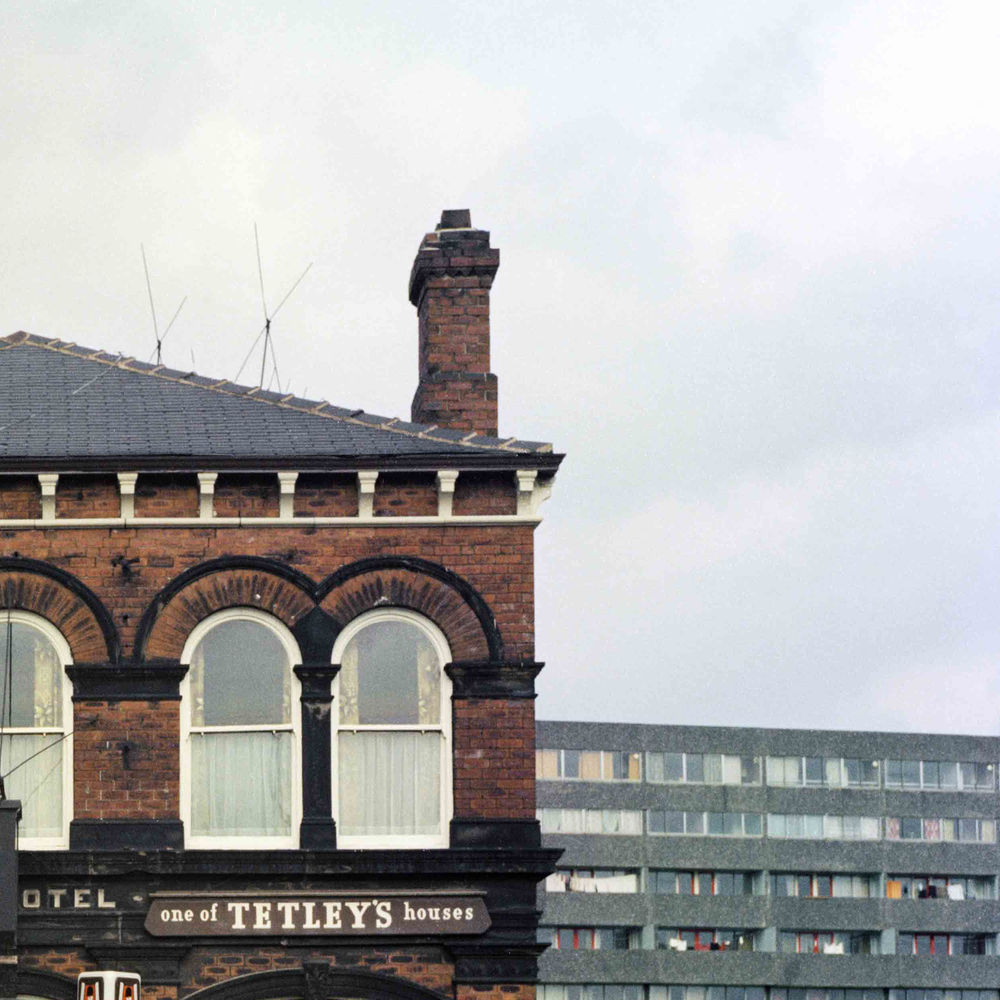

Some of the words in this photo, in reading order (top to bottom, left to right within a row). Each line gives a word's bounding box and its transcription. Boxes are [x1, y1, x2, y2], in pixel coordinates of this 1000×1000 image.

[22, 888, 116, 909] OTEL
[160, 909, 194, 923] one
[200, 903, 218, 922] of
[227, 899, 393, 930] TETLEY'S
[403, 902, 474, 921] houses
